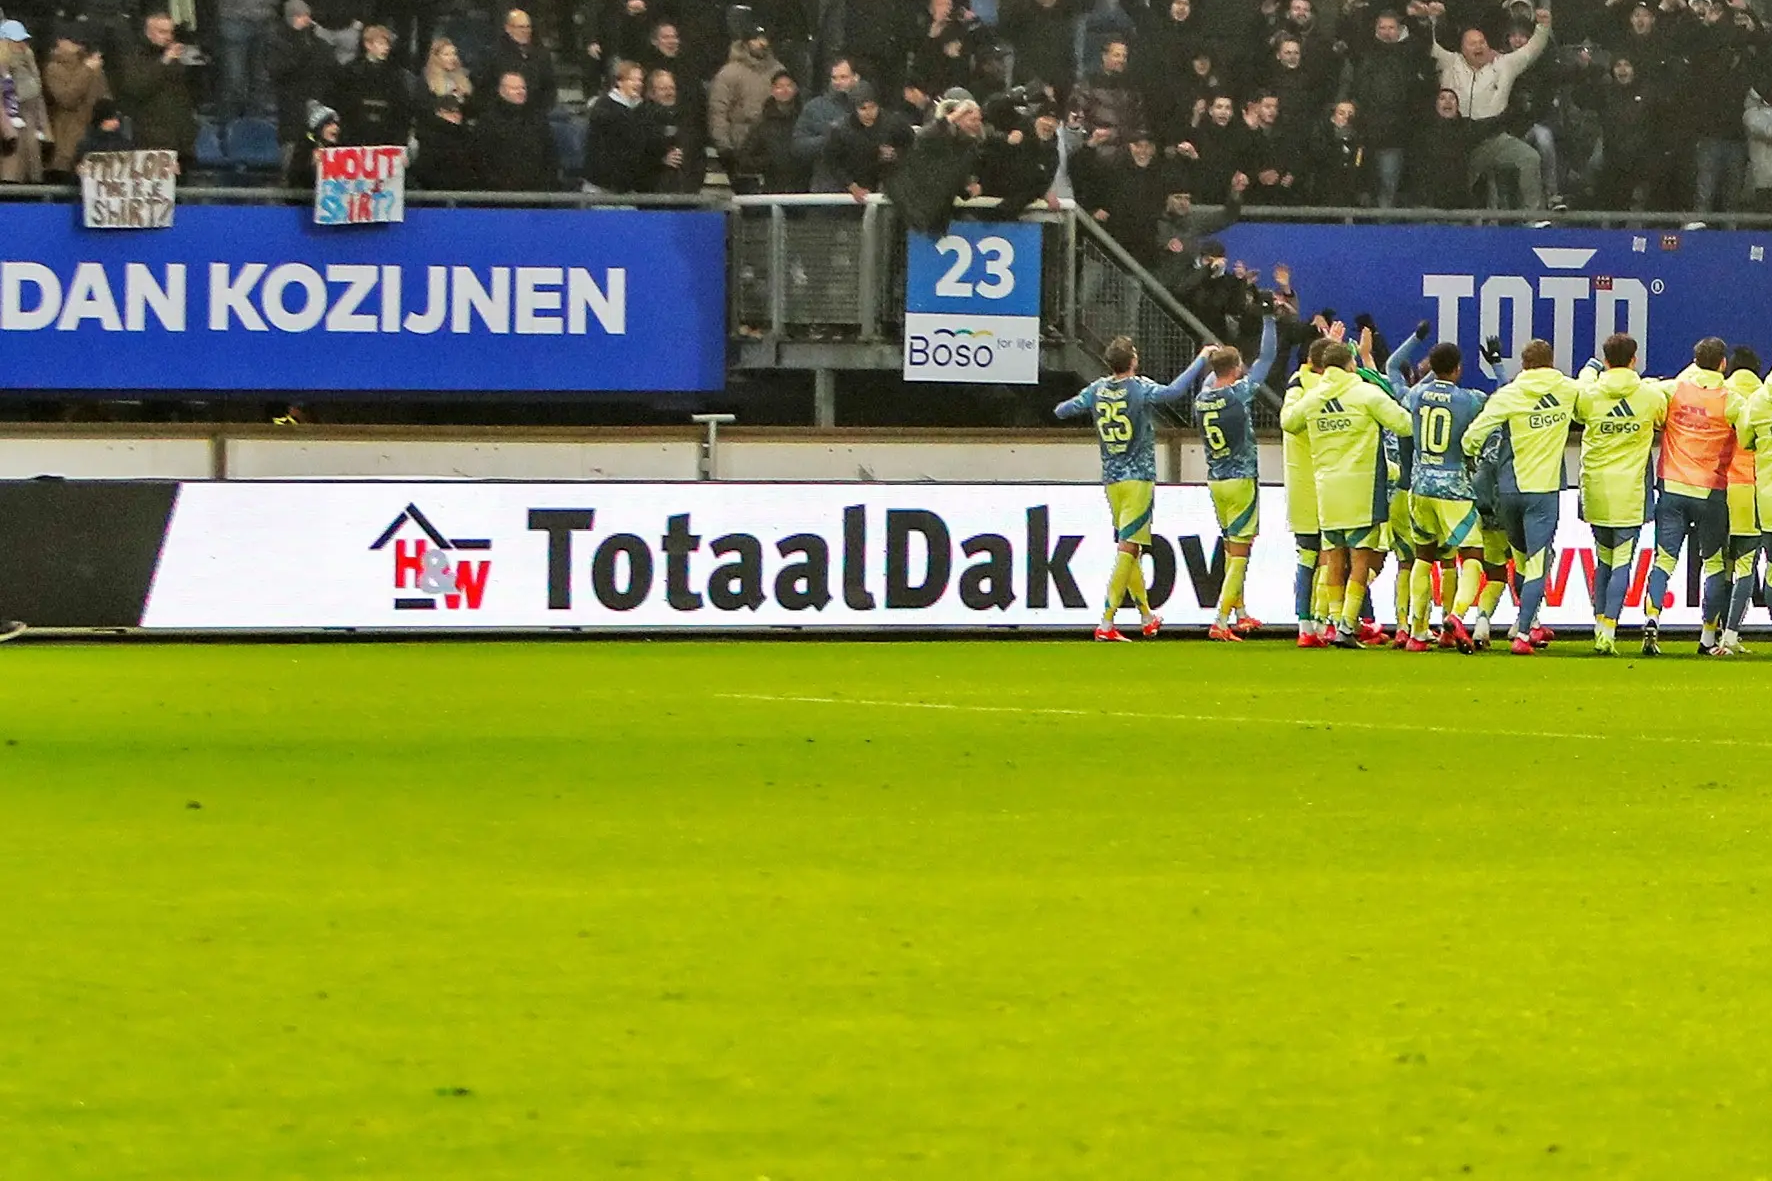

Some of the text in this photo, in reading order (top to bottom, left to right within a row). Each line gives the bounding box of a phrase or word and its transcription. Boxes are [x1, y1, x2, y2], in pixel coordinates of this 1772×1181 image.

[208, 262, 627, 336] KOZIJNEN
[934, 235, 1015, 299] 23
[909, 335, 993, 368] Boso
[1423, 274, 1649, 377] TOTO
[1096, 401, 1133, 443] 25
[1202, 411, 1227, 451] 6
[1419, 405, 1452, 454] 10
[395, 538, 492, 610] H&W
[528, 503, 1088, 612] TotaalDak
